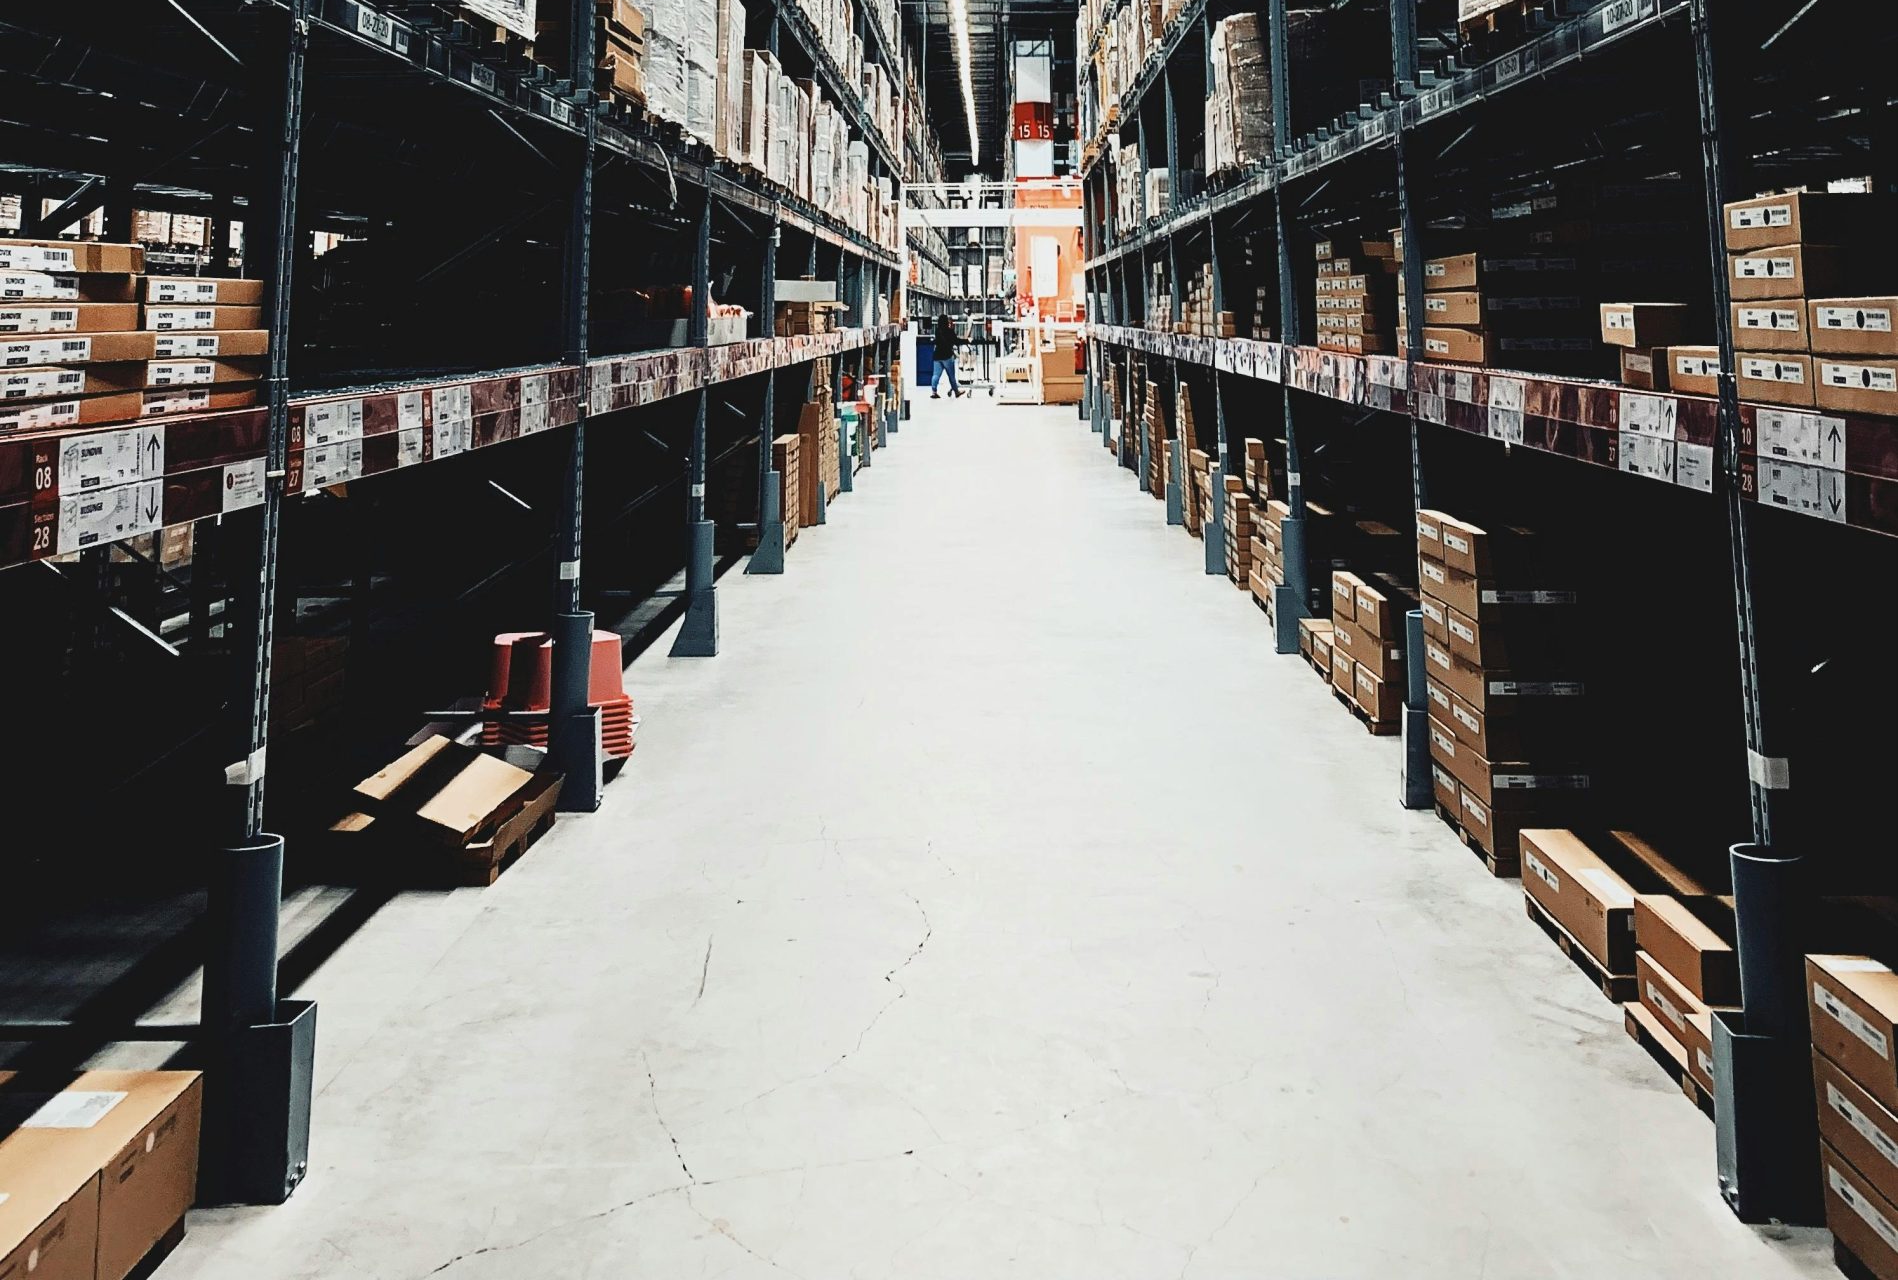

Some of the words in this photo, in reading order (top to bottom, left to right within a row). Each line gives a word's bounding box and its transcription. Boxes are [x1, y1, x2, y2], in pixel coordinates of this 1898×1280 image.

[362, 11, 389, 39] 08-27-20
[1018, 125, 1031, 138] 15
[1038, 125, 1050, 138] 15
[291, 425, 301, 443] 08
[1741, 427, 1752, 446] 10
[36, 466, 52, 490] 08
[288, 469, 300, 488] 27
[1741, 473, 1753, 493] 28
[33, 526, 50, 551] 28
